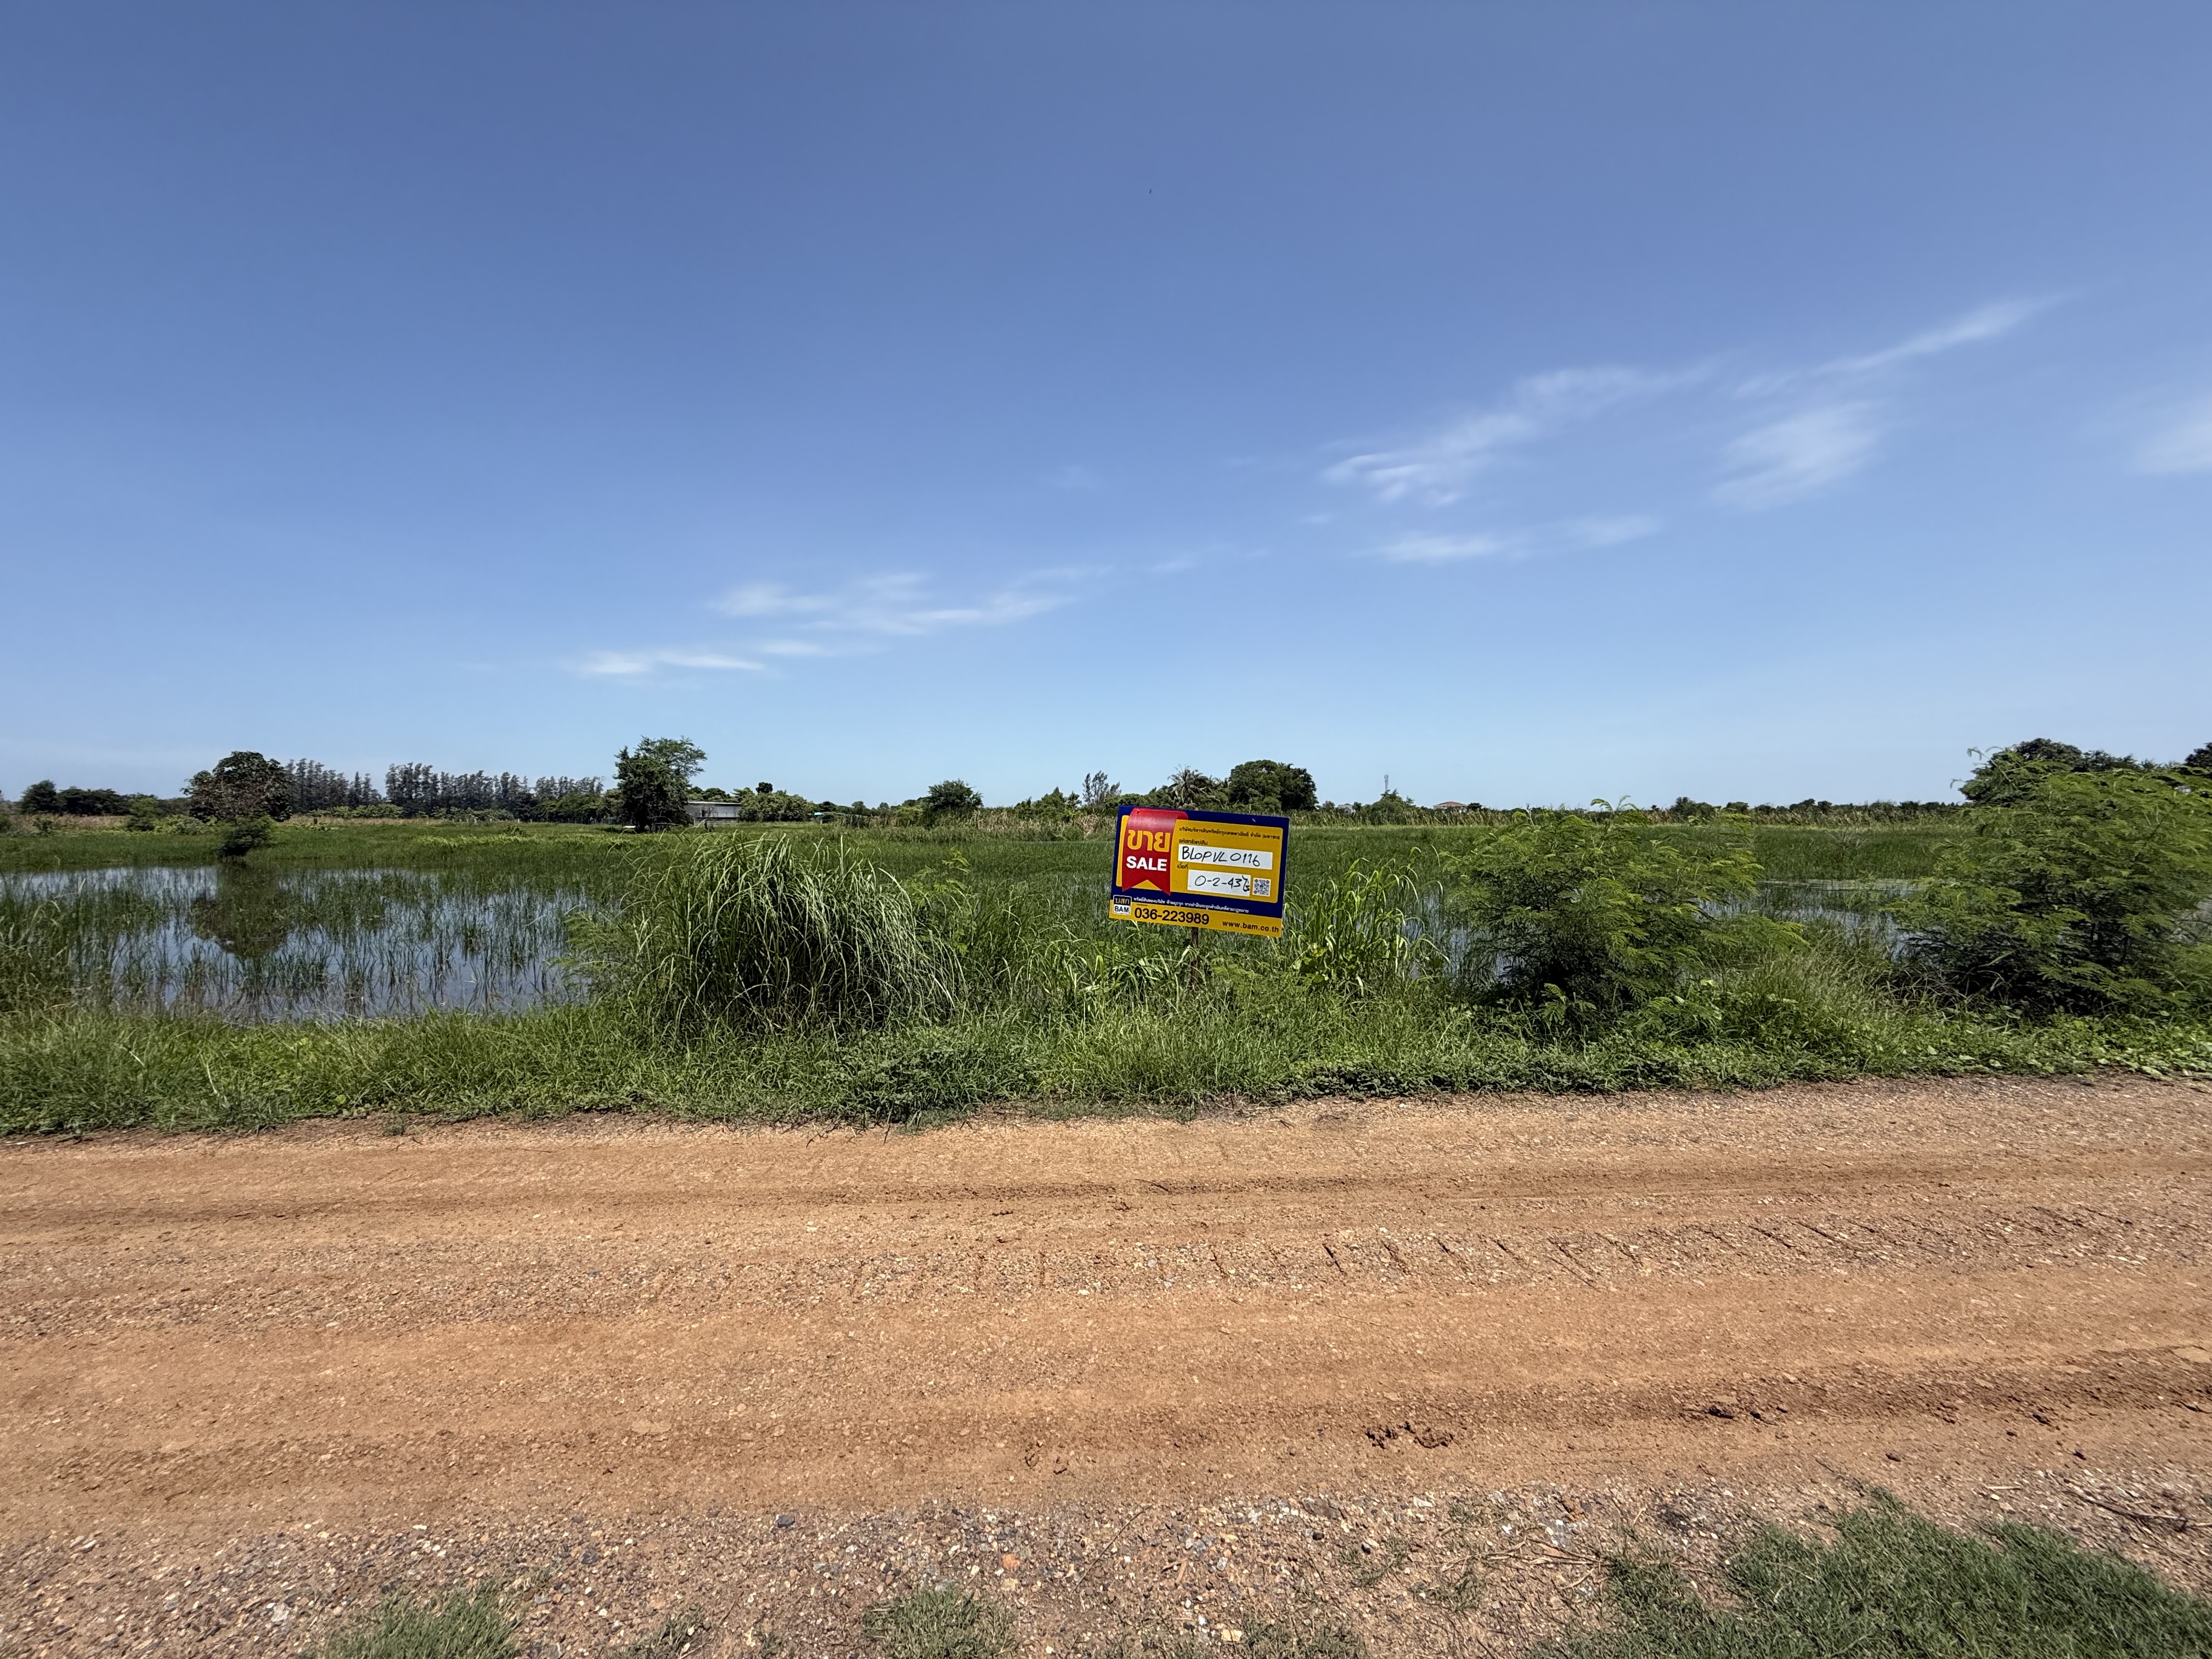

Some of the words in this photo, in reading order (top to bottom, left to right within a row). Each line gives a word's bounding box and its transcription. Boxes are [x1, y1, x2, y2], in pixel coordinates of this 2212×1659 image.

[1127, 830, 1171, 853] ขาย
[1126, 856, 1167, 872] SALE
[1135, 907, 1210, 925] 036-223989
[1222, 921, 1279, 933] www.bam.co.th
